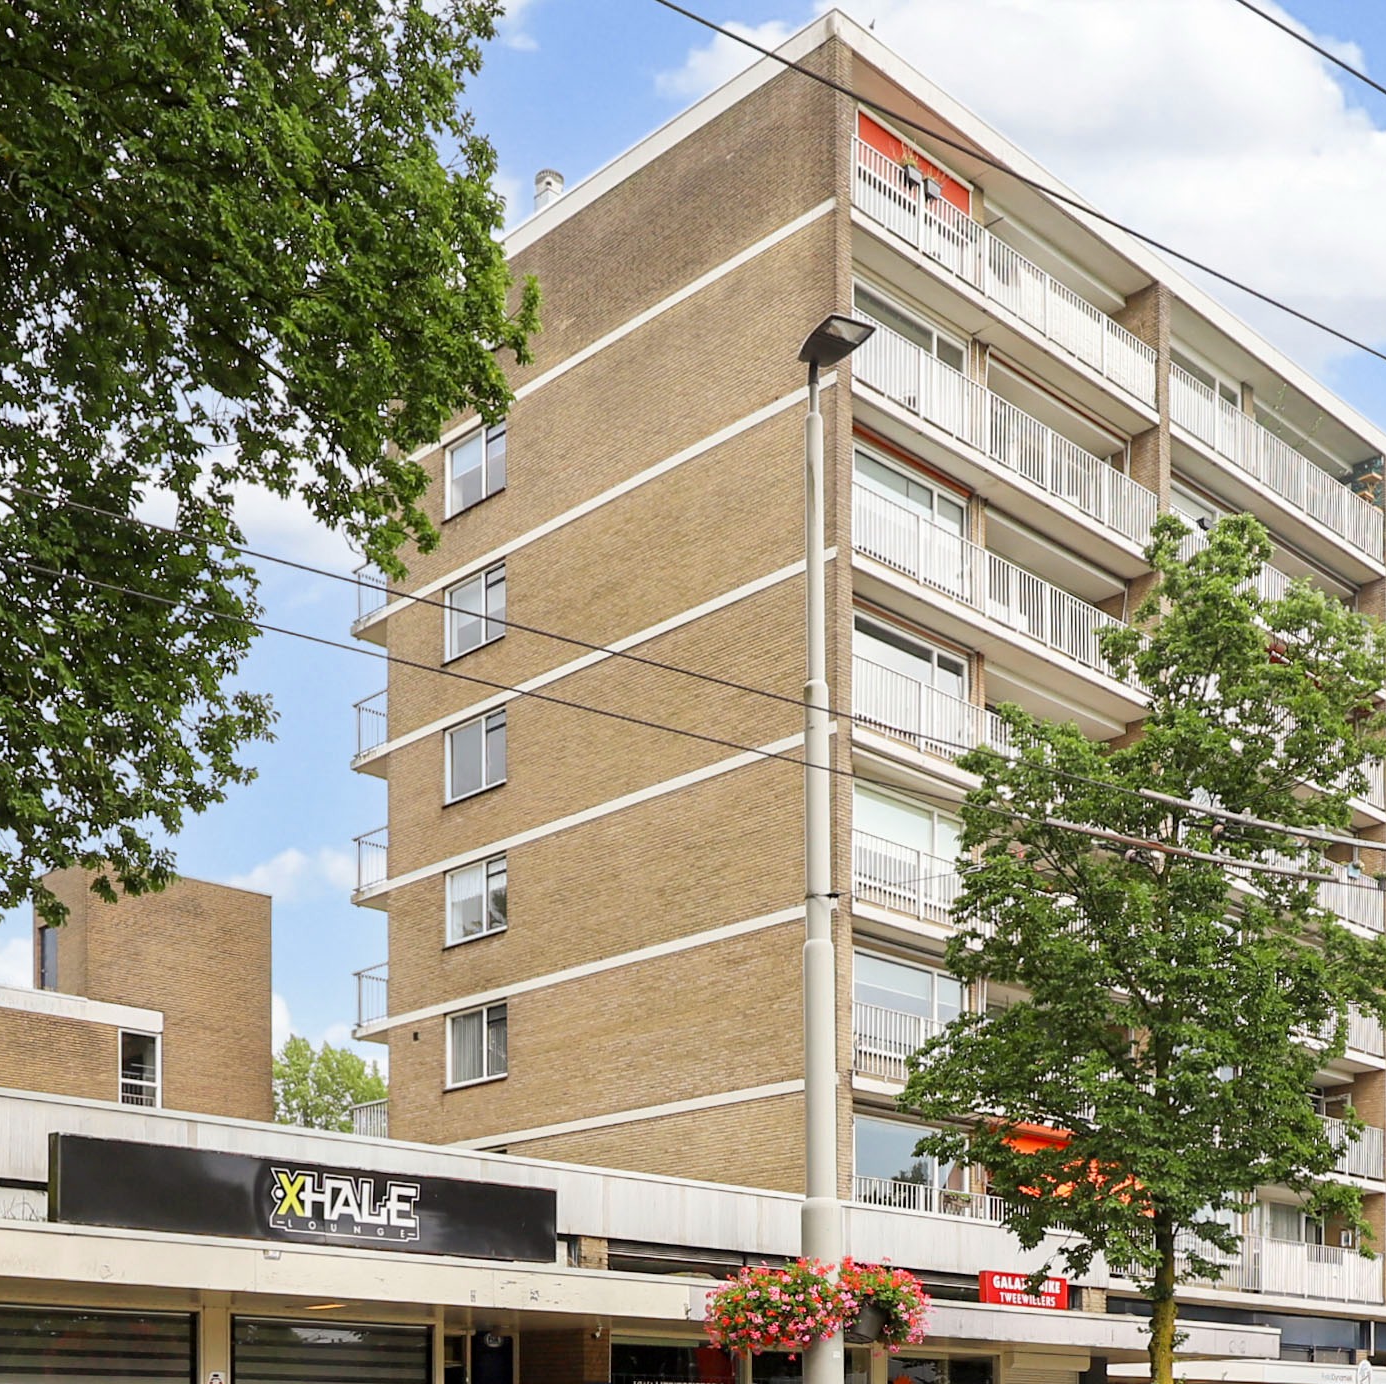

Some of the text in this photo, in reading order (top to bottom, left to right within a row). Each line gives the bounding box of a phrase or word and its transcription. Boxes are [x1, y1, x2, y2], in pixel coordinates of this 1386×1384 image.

[276, 1172, 417, 1228] XHALE
[288, 1219, 405, 1238] LOUNGE
[992, 1274, 1032, 1291] GALA
